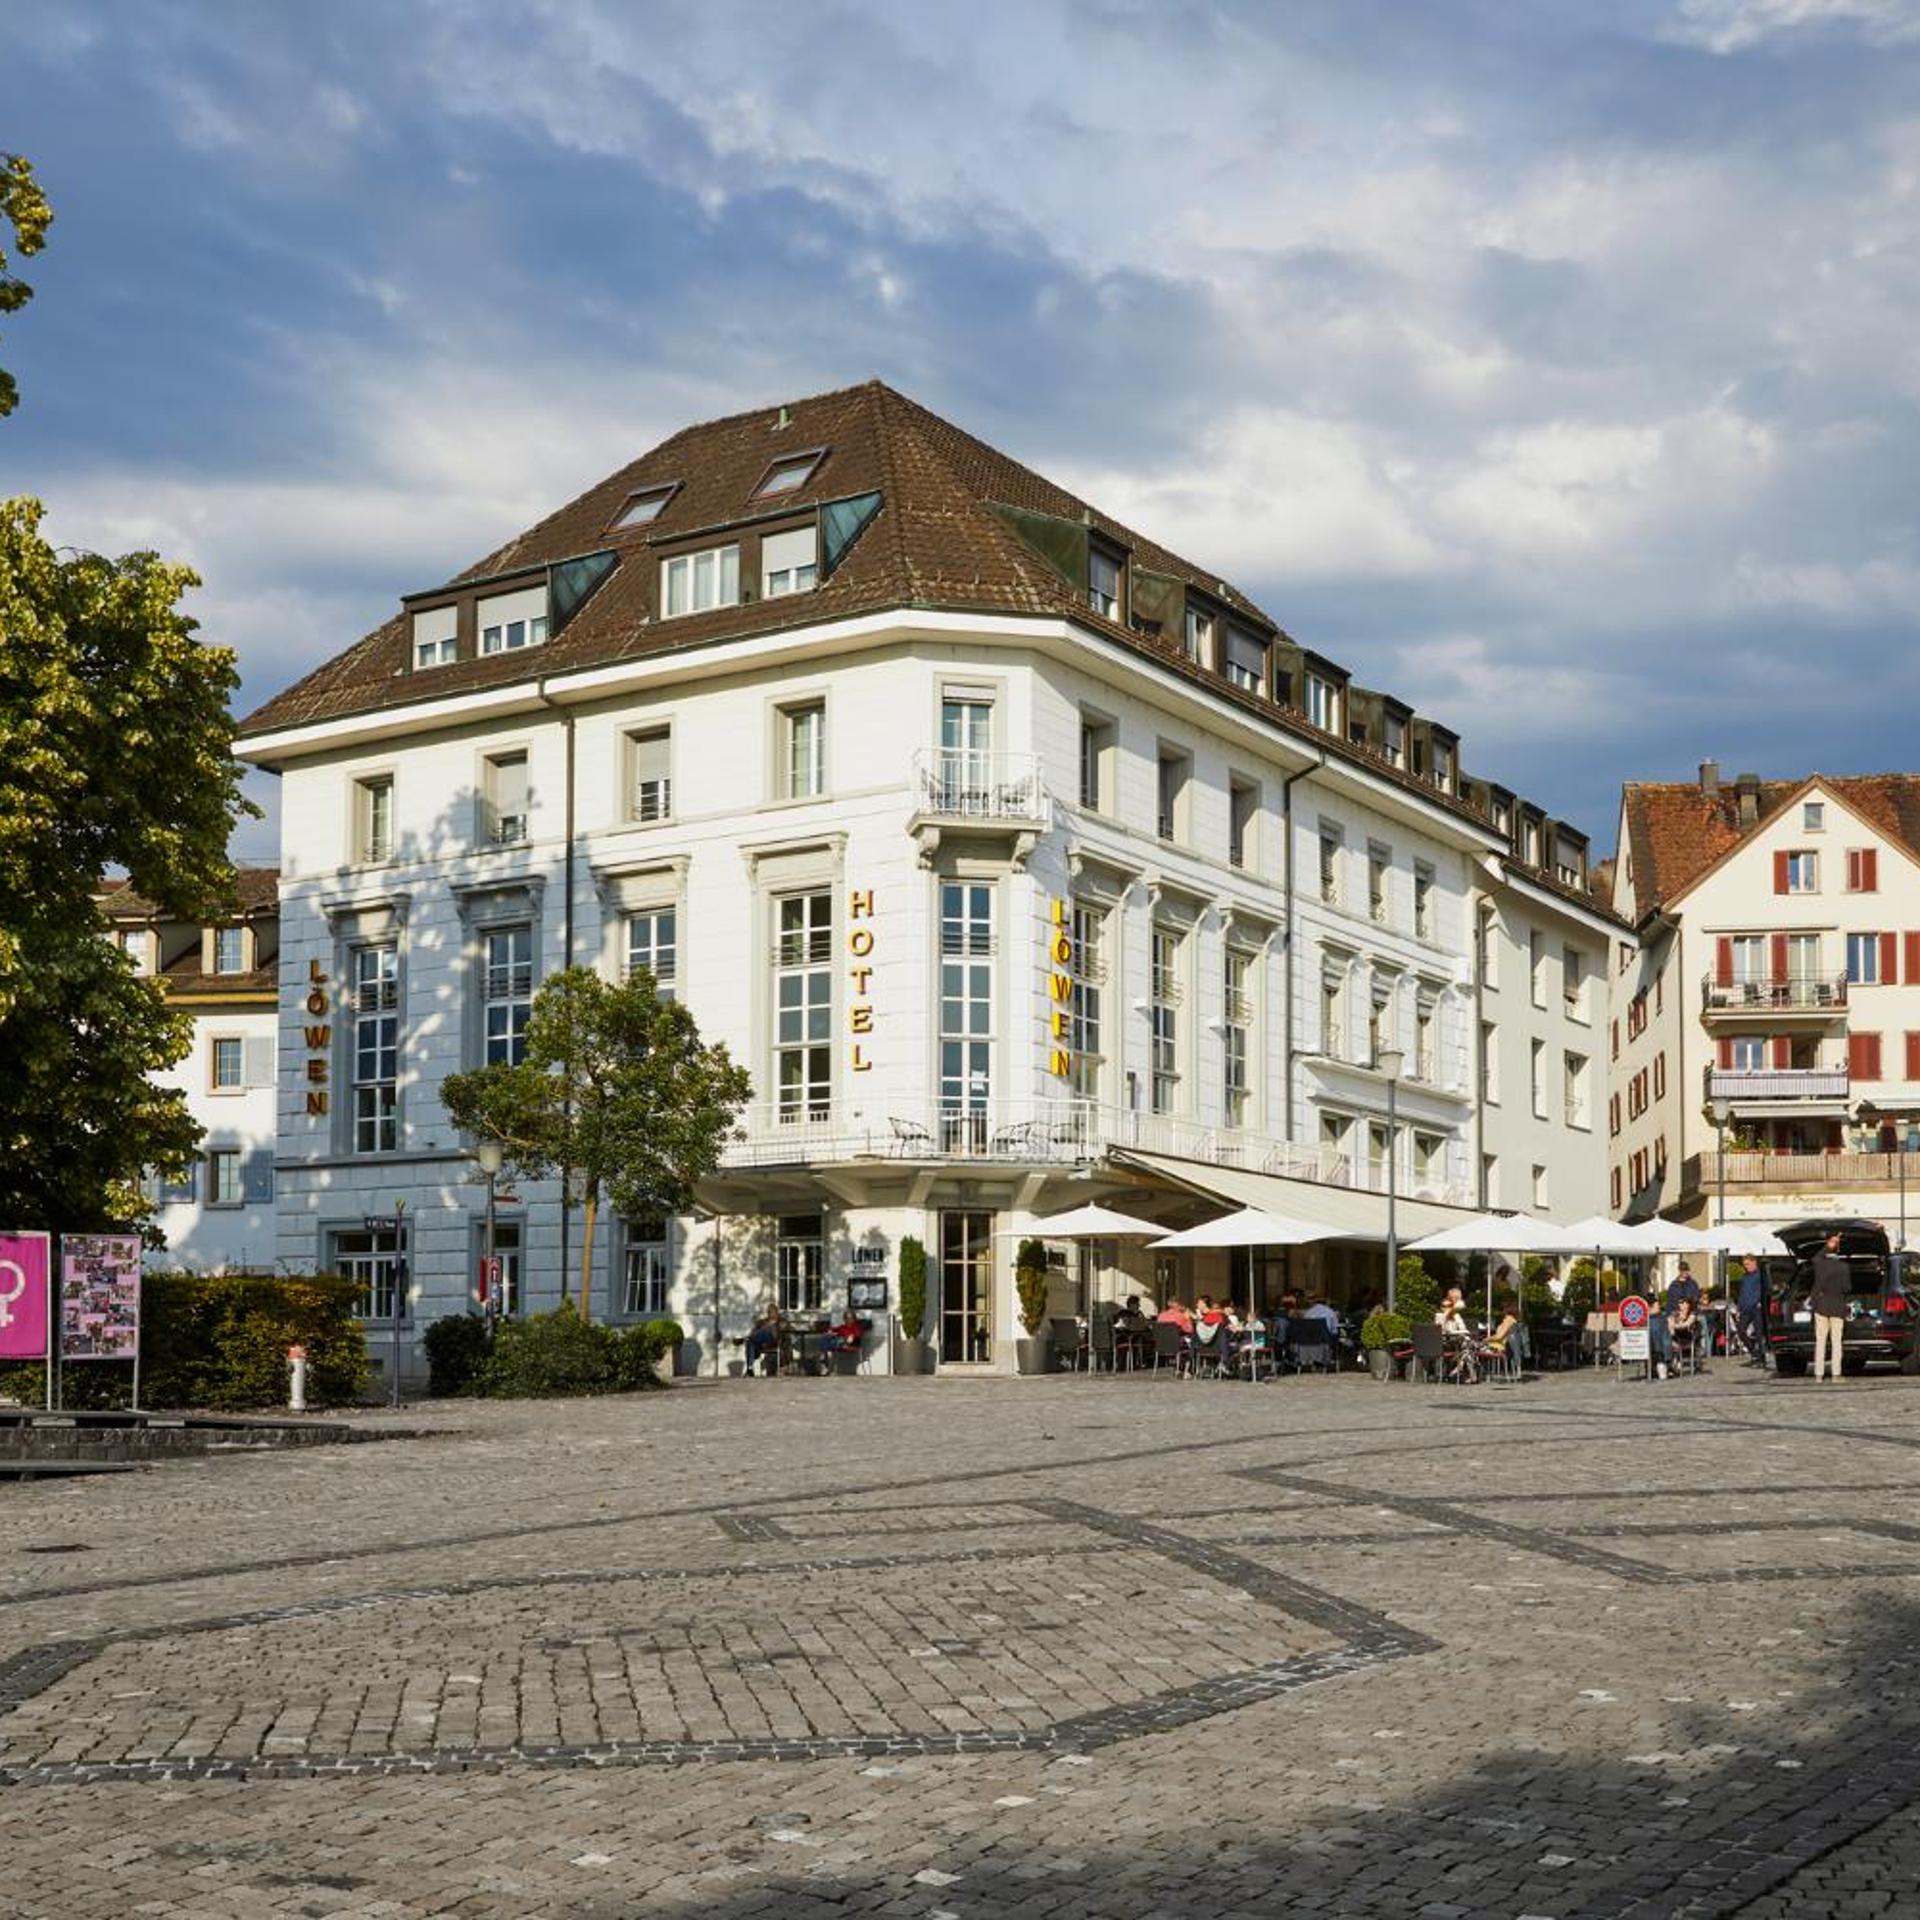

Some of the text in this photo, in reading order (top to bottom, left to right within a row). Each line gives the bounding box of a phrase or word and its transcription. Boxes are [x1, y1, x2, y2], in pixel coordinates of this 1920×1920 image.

[304, 959, 331, 1116] LÖWEN
[850, 890, 874, 1071] HOTEL
[1051, 898, 1073, 1077] LÖWEN
